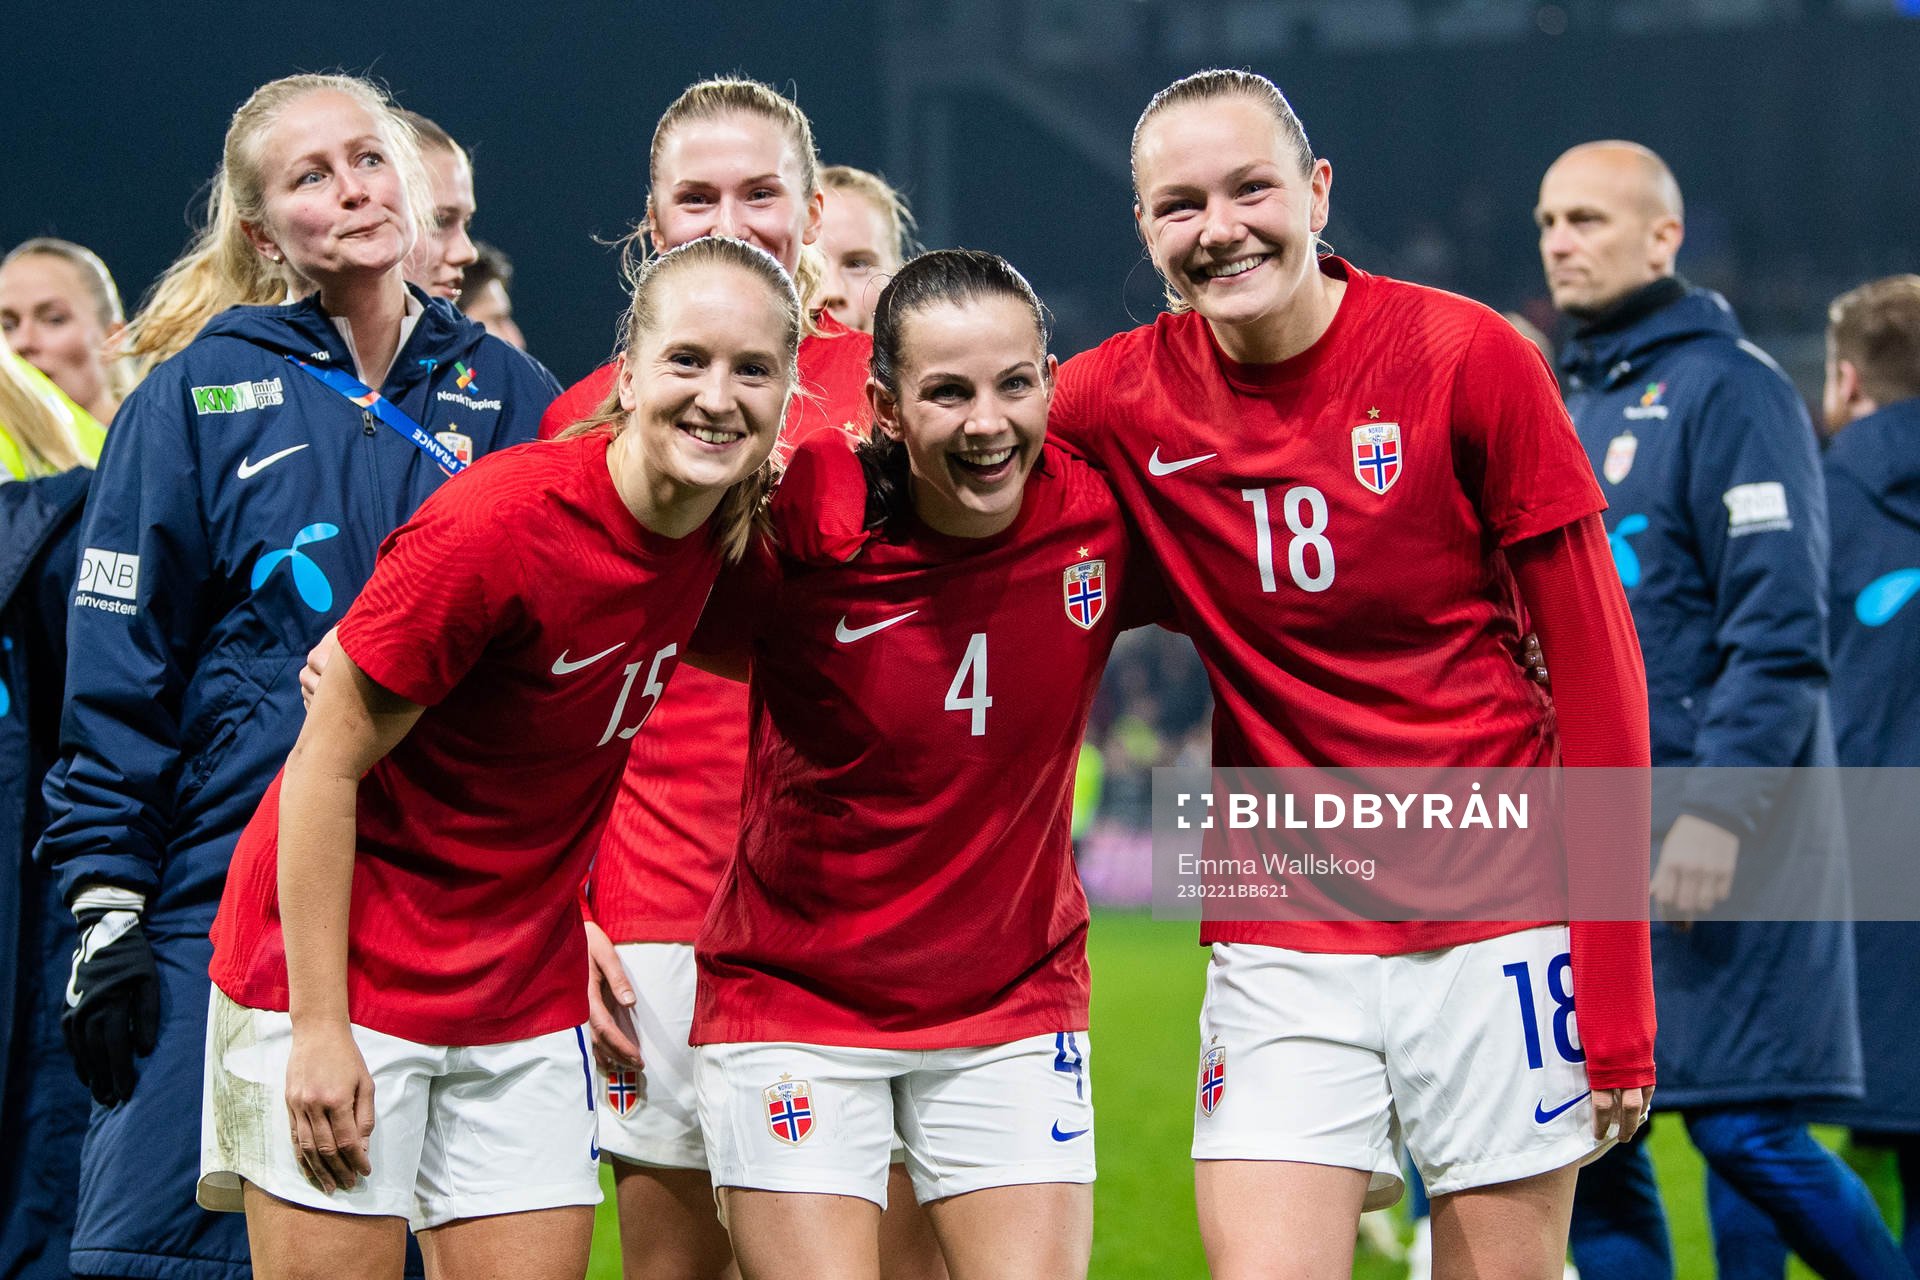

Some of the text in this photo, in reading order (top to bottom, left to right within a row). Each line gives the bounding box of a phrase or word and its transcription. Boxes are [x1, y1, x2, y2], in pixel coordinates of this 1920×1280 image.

[254, 378, 282, 393] mini
[257, 392, 284, 409] pris
[412, 428, 457, 470] FRANCE
[79, 552, 134, 592] DNB
[1241, 486, 1336, 592] 18
[596, 642, 677, 747] 15
[944, 633, 993, 736] 4
[1502, 952, 1587, 1070] 18
[1054, 1032, 1083, 1101] 4
